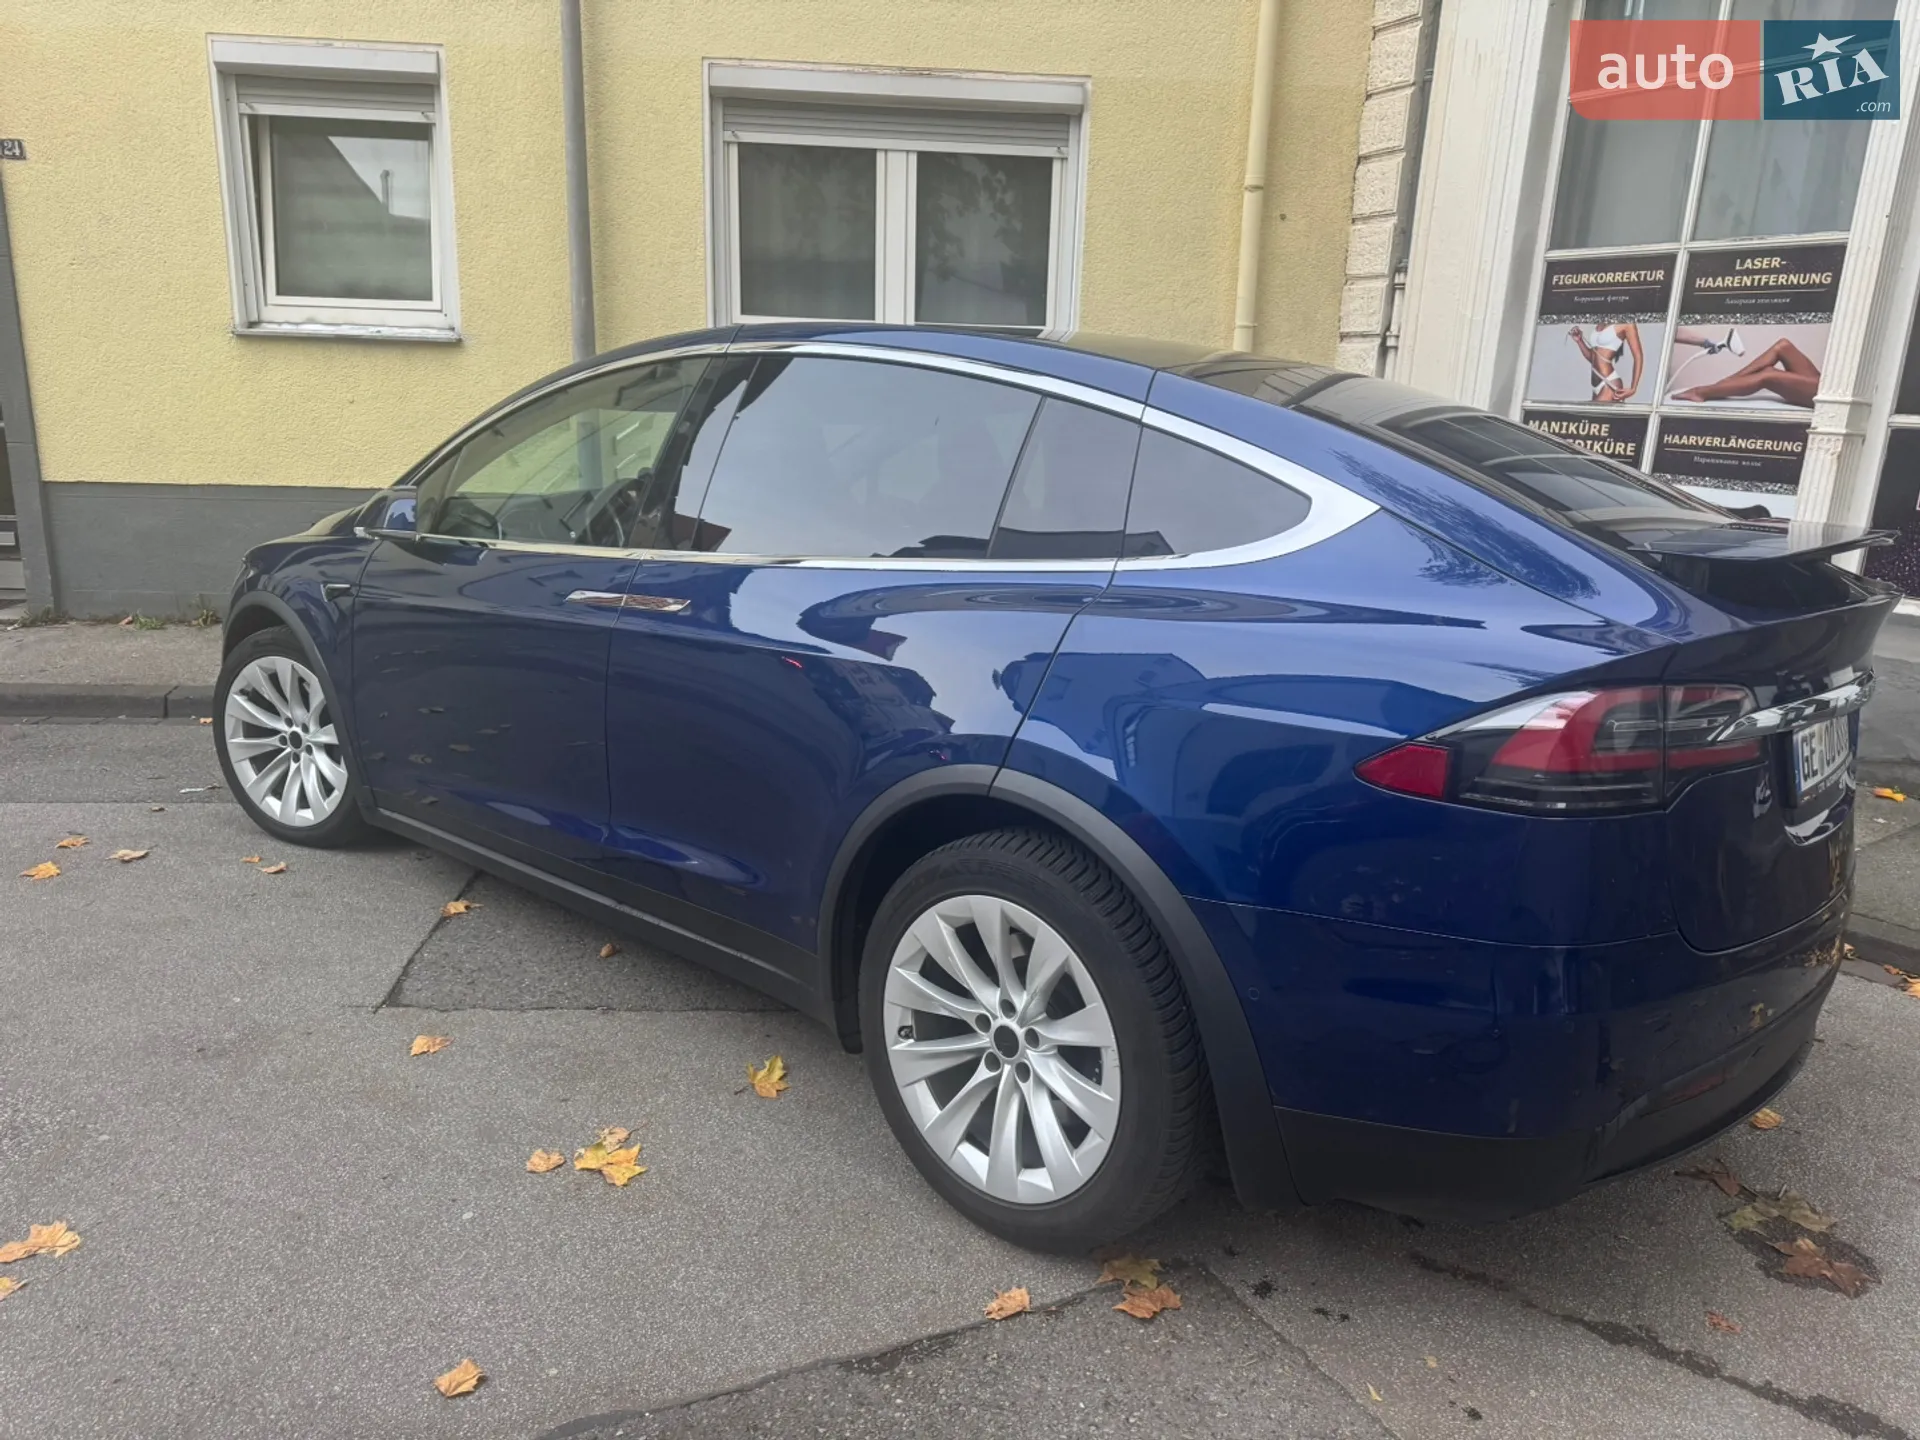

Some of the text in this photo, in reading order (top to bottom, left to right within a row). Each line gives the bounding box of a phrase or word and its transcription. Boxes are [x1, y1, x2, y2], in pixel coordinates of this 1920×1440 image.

[1735, 257, 1787, 270] LASER-
[1552, 269, 1665, 286] FIGURKORREKTUR
[1695, 272, 1833, 289] HAARENTFERNUNG
[1527, 419, 1611, 436] MANIKÜRE
[1663, 433, 1803, 452] HAARVERLÄNGERUNG
